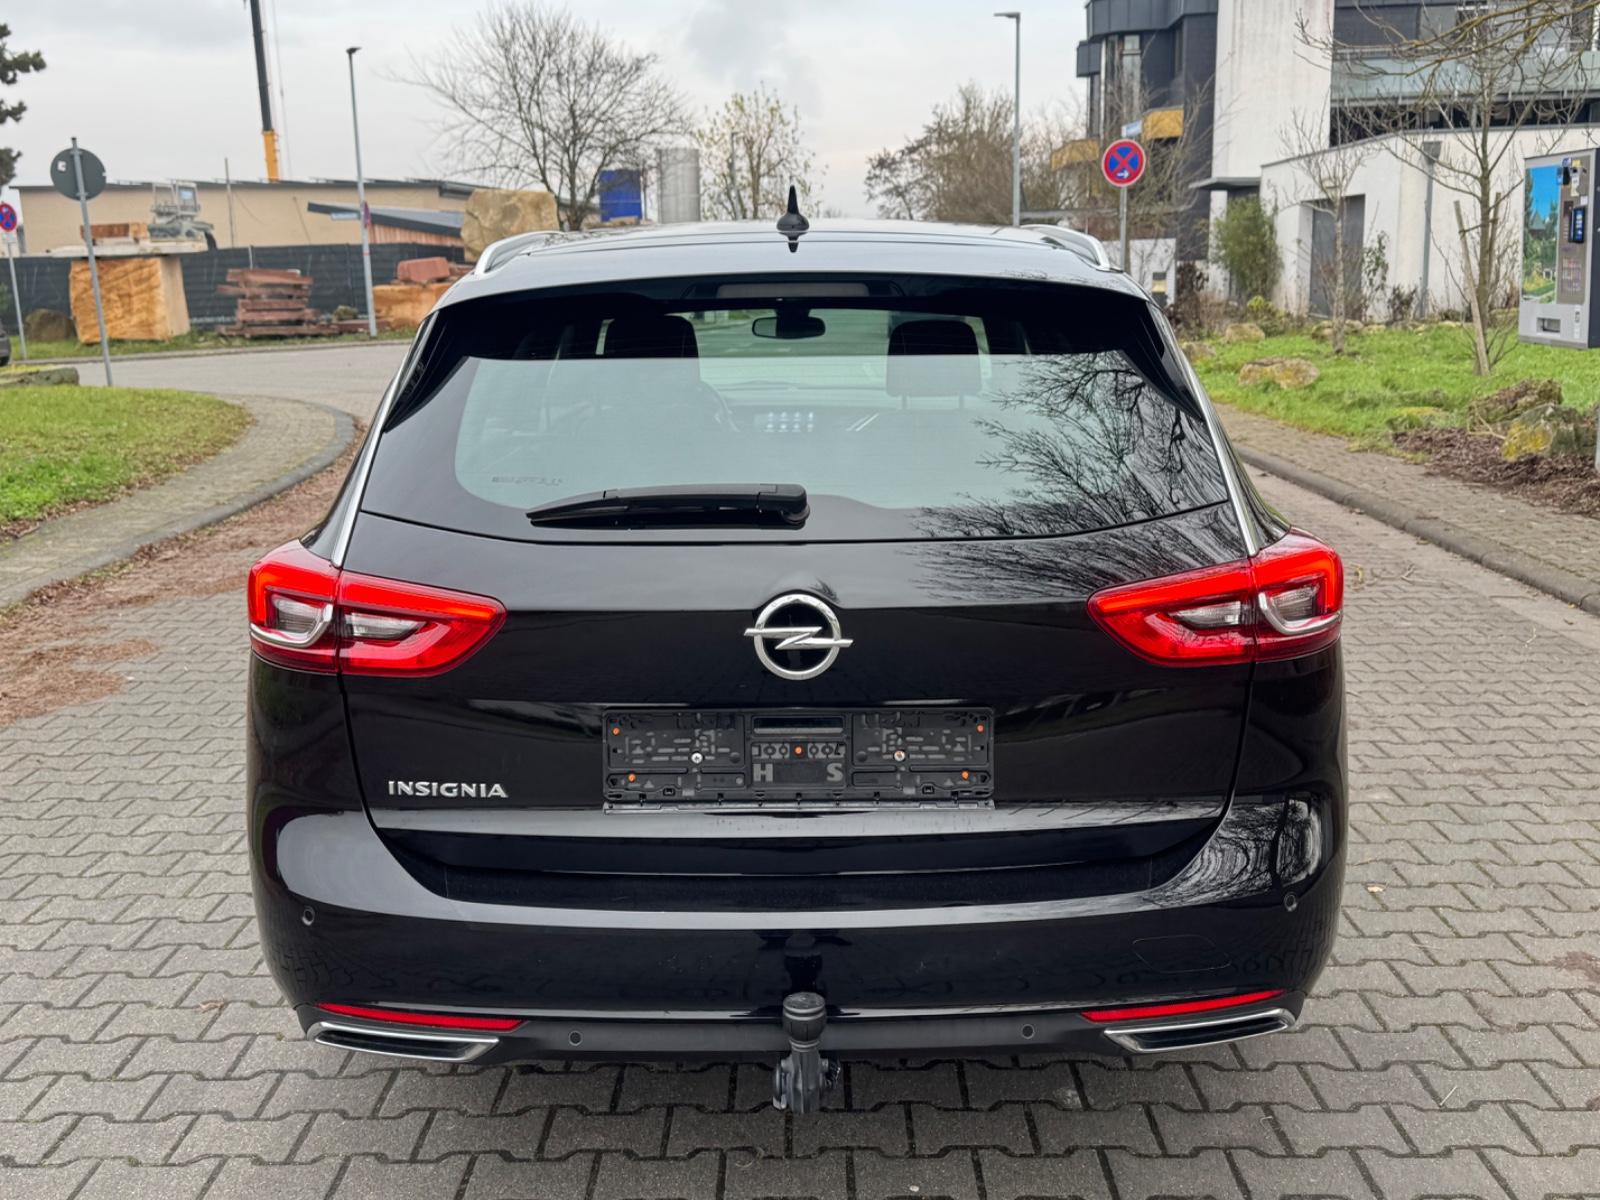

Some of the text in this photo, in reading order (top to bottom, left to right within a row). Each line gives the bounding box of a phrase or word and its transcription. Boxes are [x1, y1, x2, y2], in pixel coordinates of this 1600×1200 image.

[753, 763, 844, 782] H S
[388, 780, 509, 798] INSIGNIA
